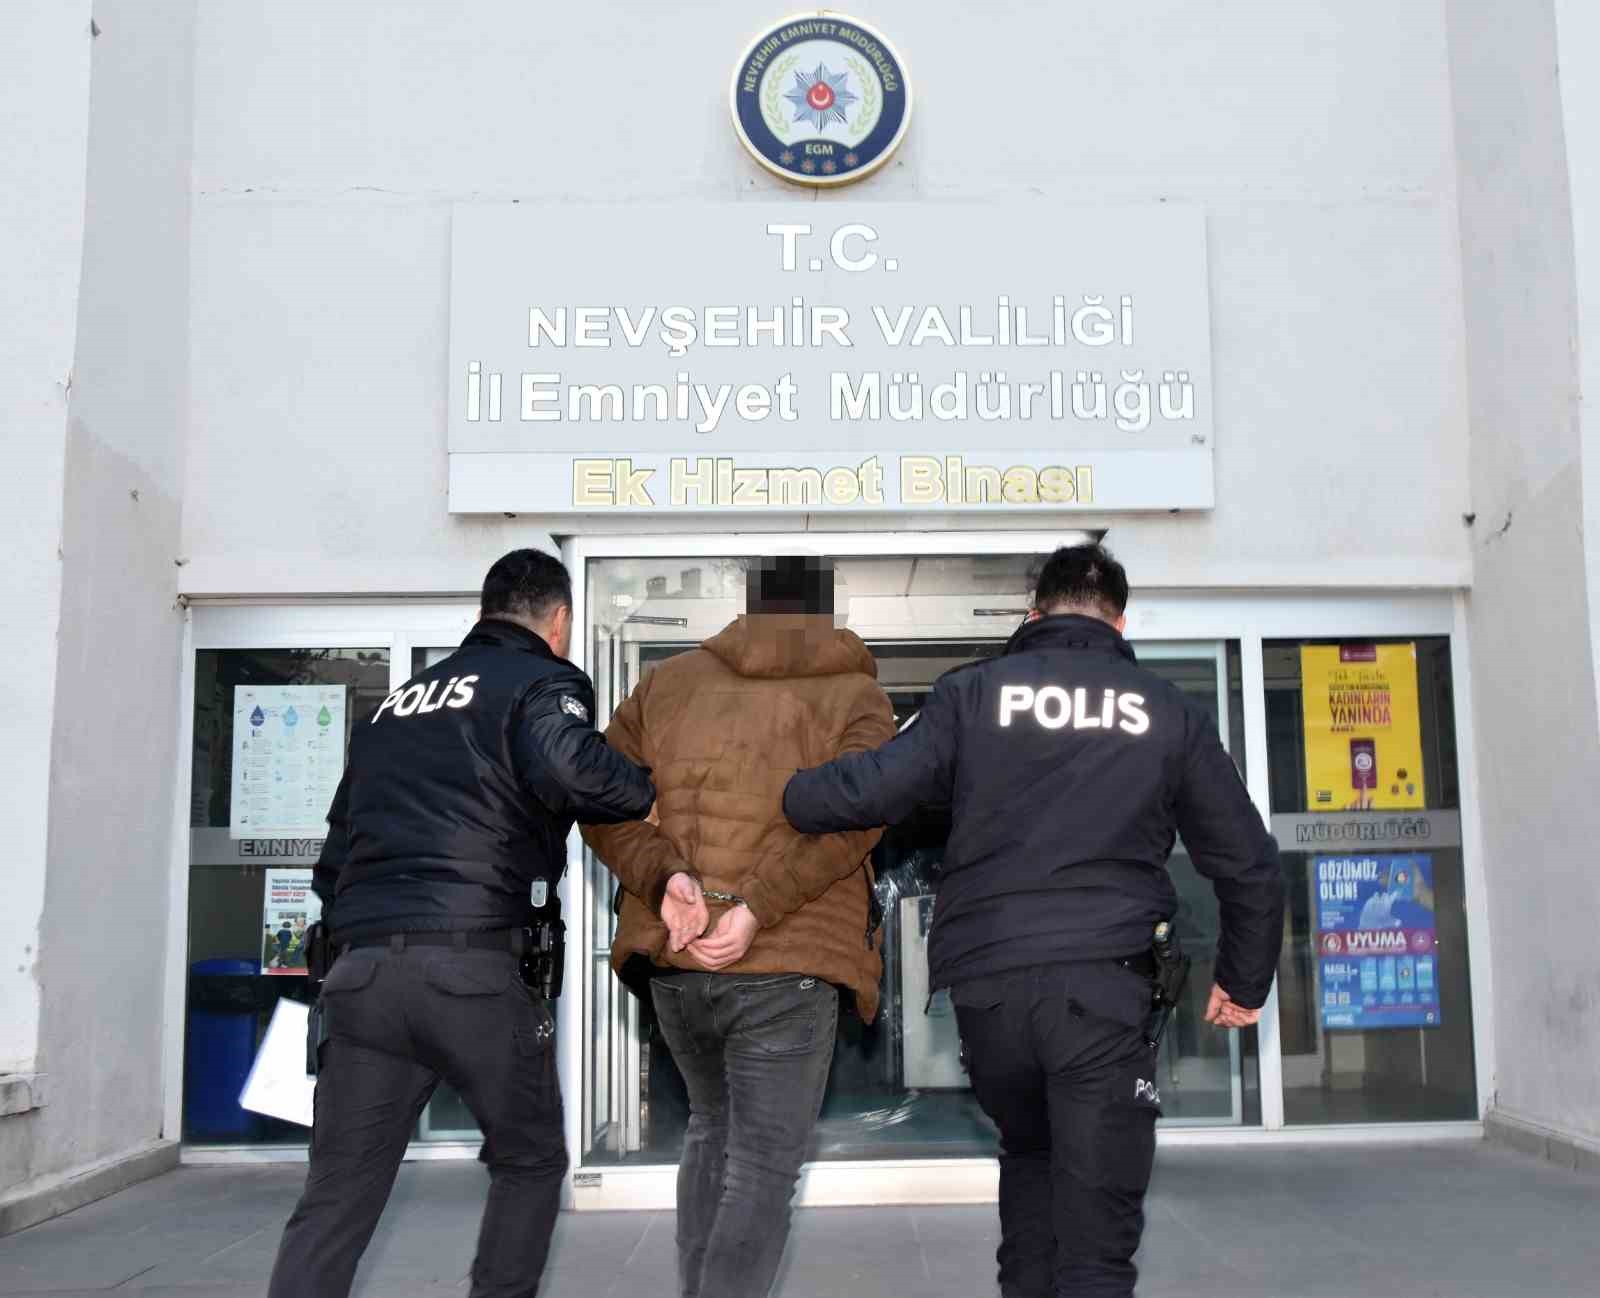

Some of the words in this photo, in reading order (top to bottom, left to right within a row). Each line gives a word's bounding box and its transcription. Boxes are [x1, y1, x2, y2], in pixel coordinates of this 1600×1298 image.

[780, 21, 836, 42] EMNİYET
[805, 143, 833, 155] EGM
[766, 223, 899, 272] T.C.
[528, 296, 854, 356] NEVŞEHİR
[872, 295, 1134, 346] VALİLİĞİ
[466, 360, 502, 422] İl
[520, 371, 799, 433] Emniyet
[829, 370, 1195, 432] Müdürlüğü
[572, 458, 656, 506] Ek
[670, 456, 885, 505] Hizmet
[900, 455, 1094, 504] Binası
[1330, 704, 1392, 724] YANINDA
[1296, 817, 1431, 842] MÜDÜRLÜĞÜ
[1319, 859, 1378, 880] GÖZÜMÜZ
[1320, 880, 1358, 900] OLUN!
[1346, 931, 1407, 947] UYUMA
